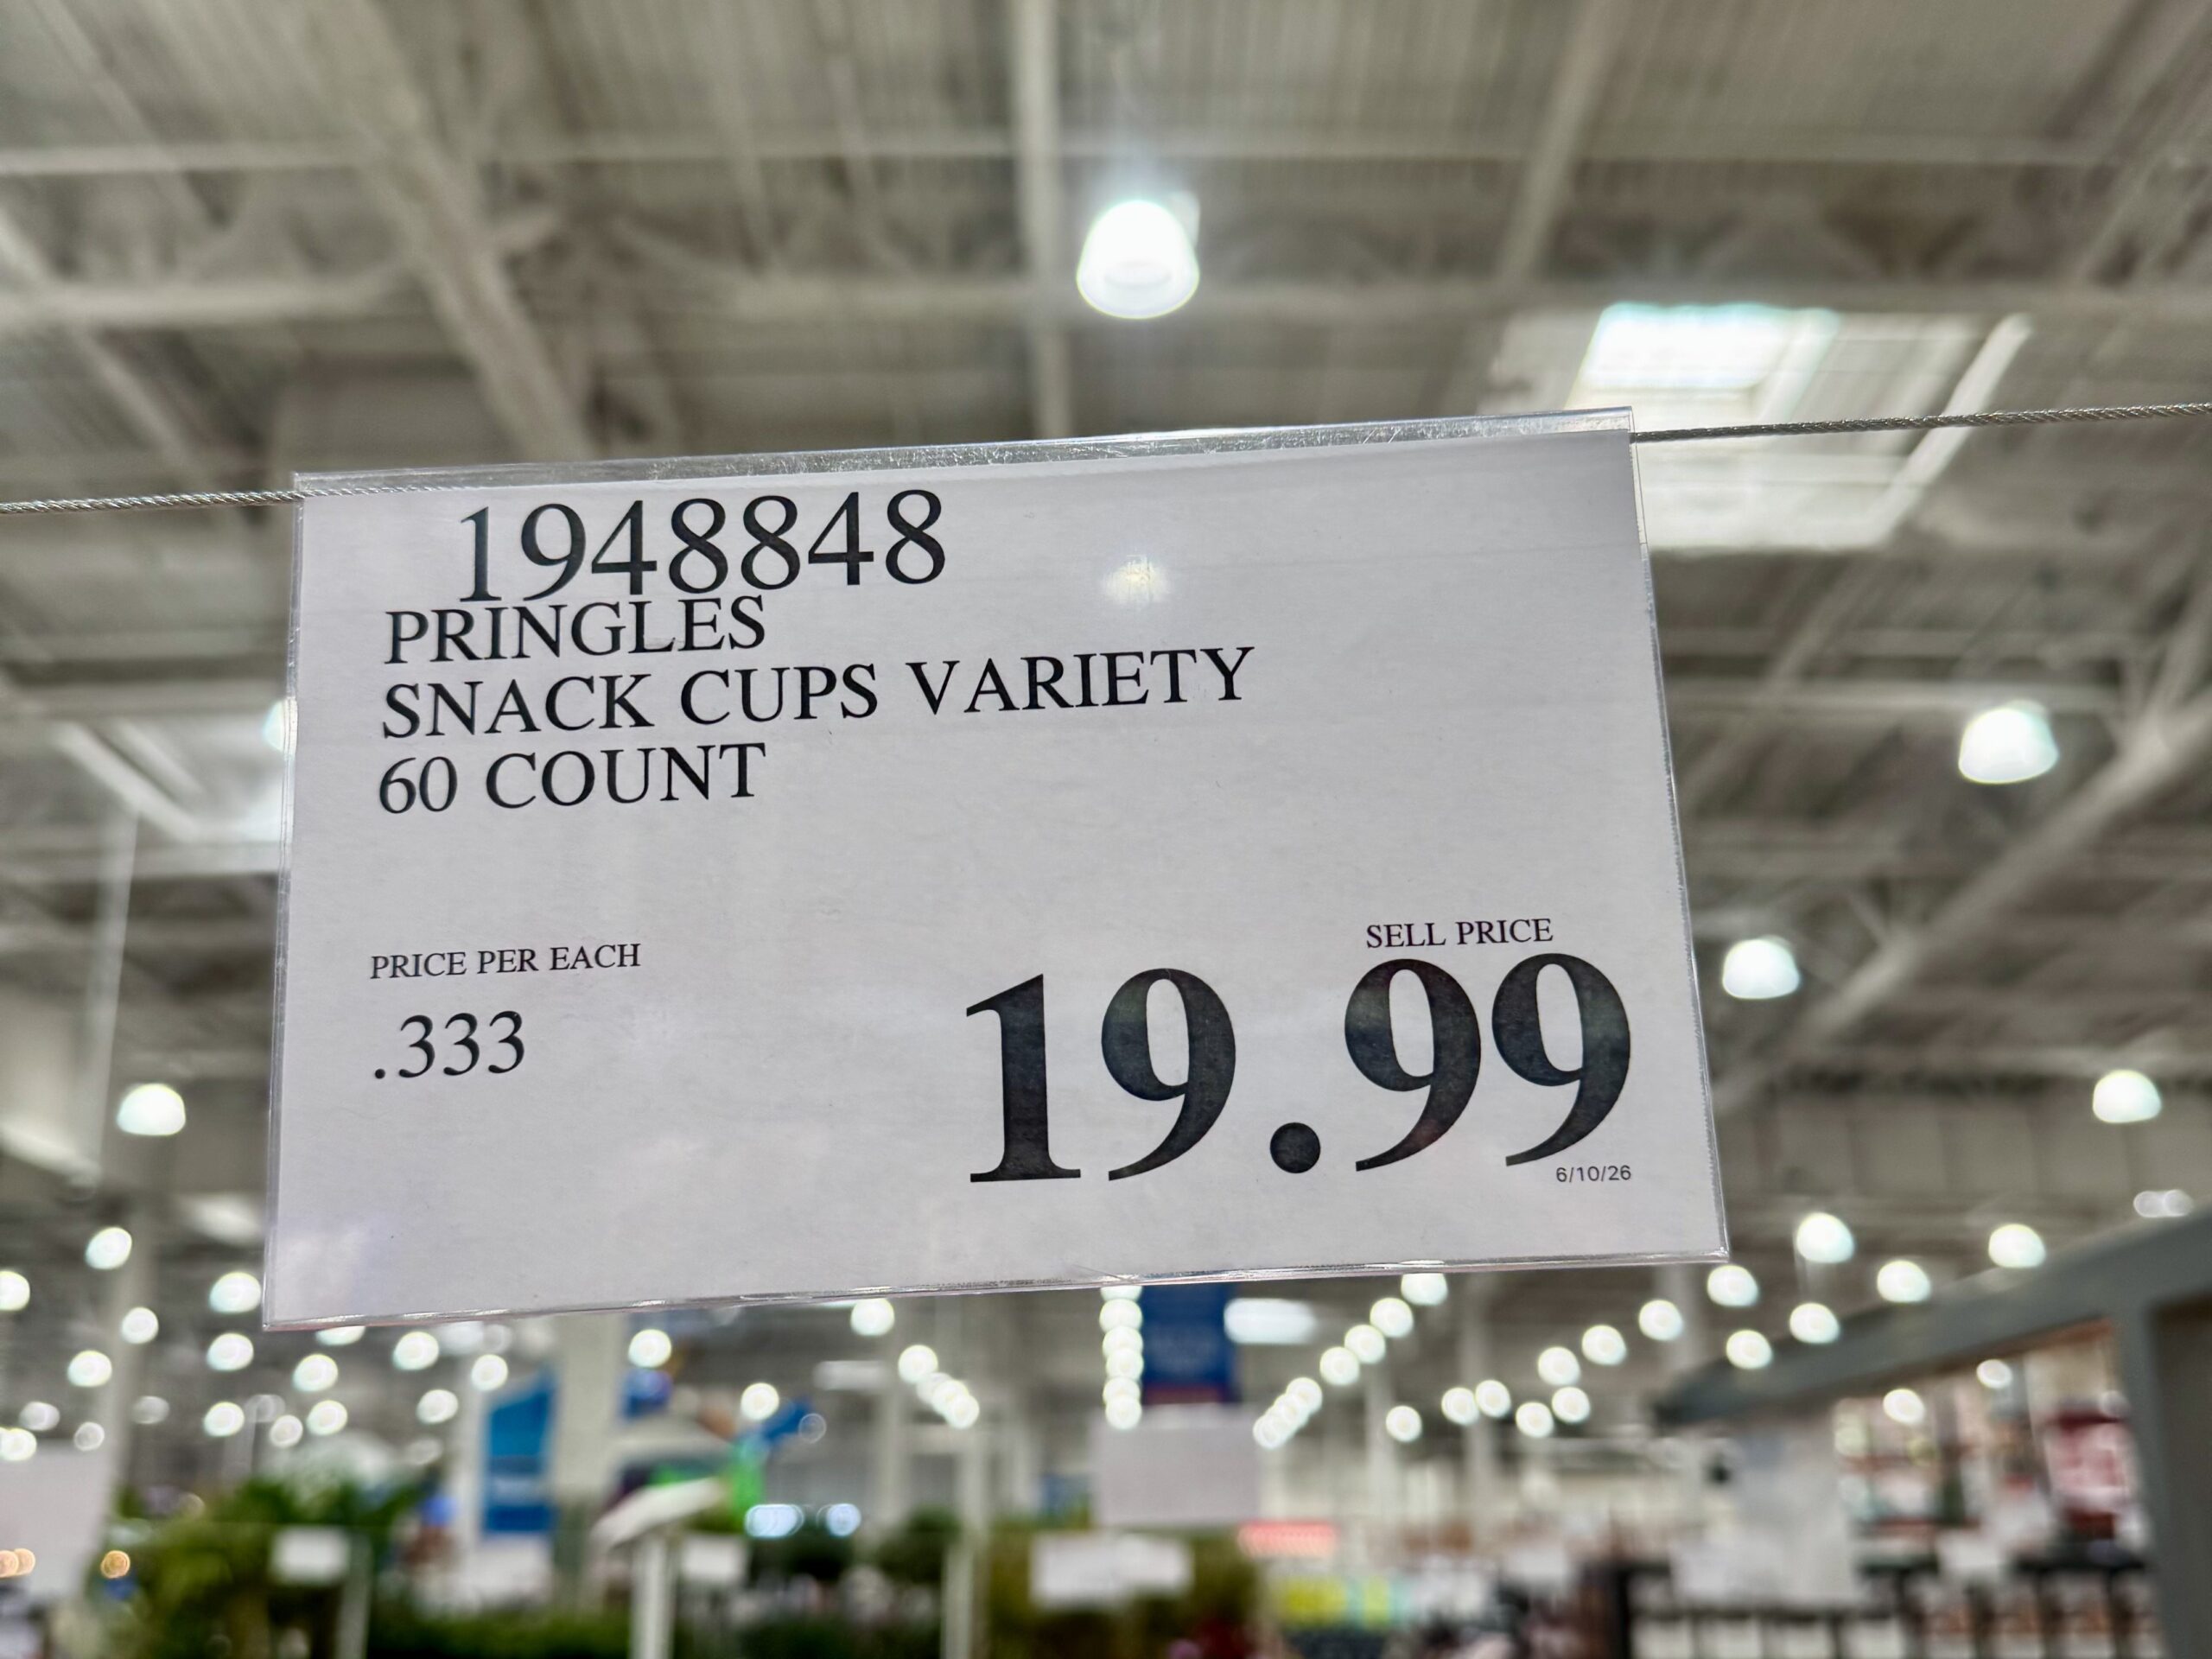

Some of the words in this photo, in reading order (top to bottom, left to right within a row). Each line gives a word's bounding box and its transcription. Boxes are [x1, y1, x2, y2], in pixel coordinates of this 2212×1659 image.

[460, 489, 946, 603] 1948848
[385, 594, 766, 664] PRINGLES
[382, 673, 656, 739] SNACK
[680, 663, 878, 726] CUPS
[905, 646, 1255, 716] VARIETY
[378, 756, 458, 815] 60
[486, 741, 766, 810] COUNT
[370, 951, 467, 980] PRICE
[477, 948, 540, 975] PER
[549, 943, 641, 971] EACH
[1366, 922, 1446, 949] SELL
[1455, 918, 1554, 945] PRICE
[374, 1010, 524, 1080] .333
[966, 952, 1631, 1183] 19.99
[1555, 1164, 1632, 1184] 6/10/26
